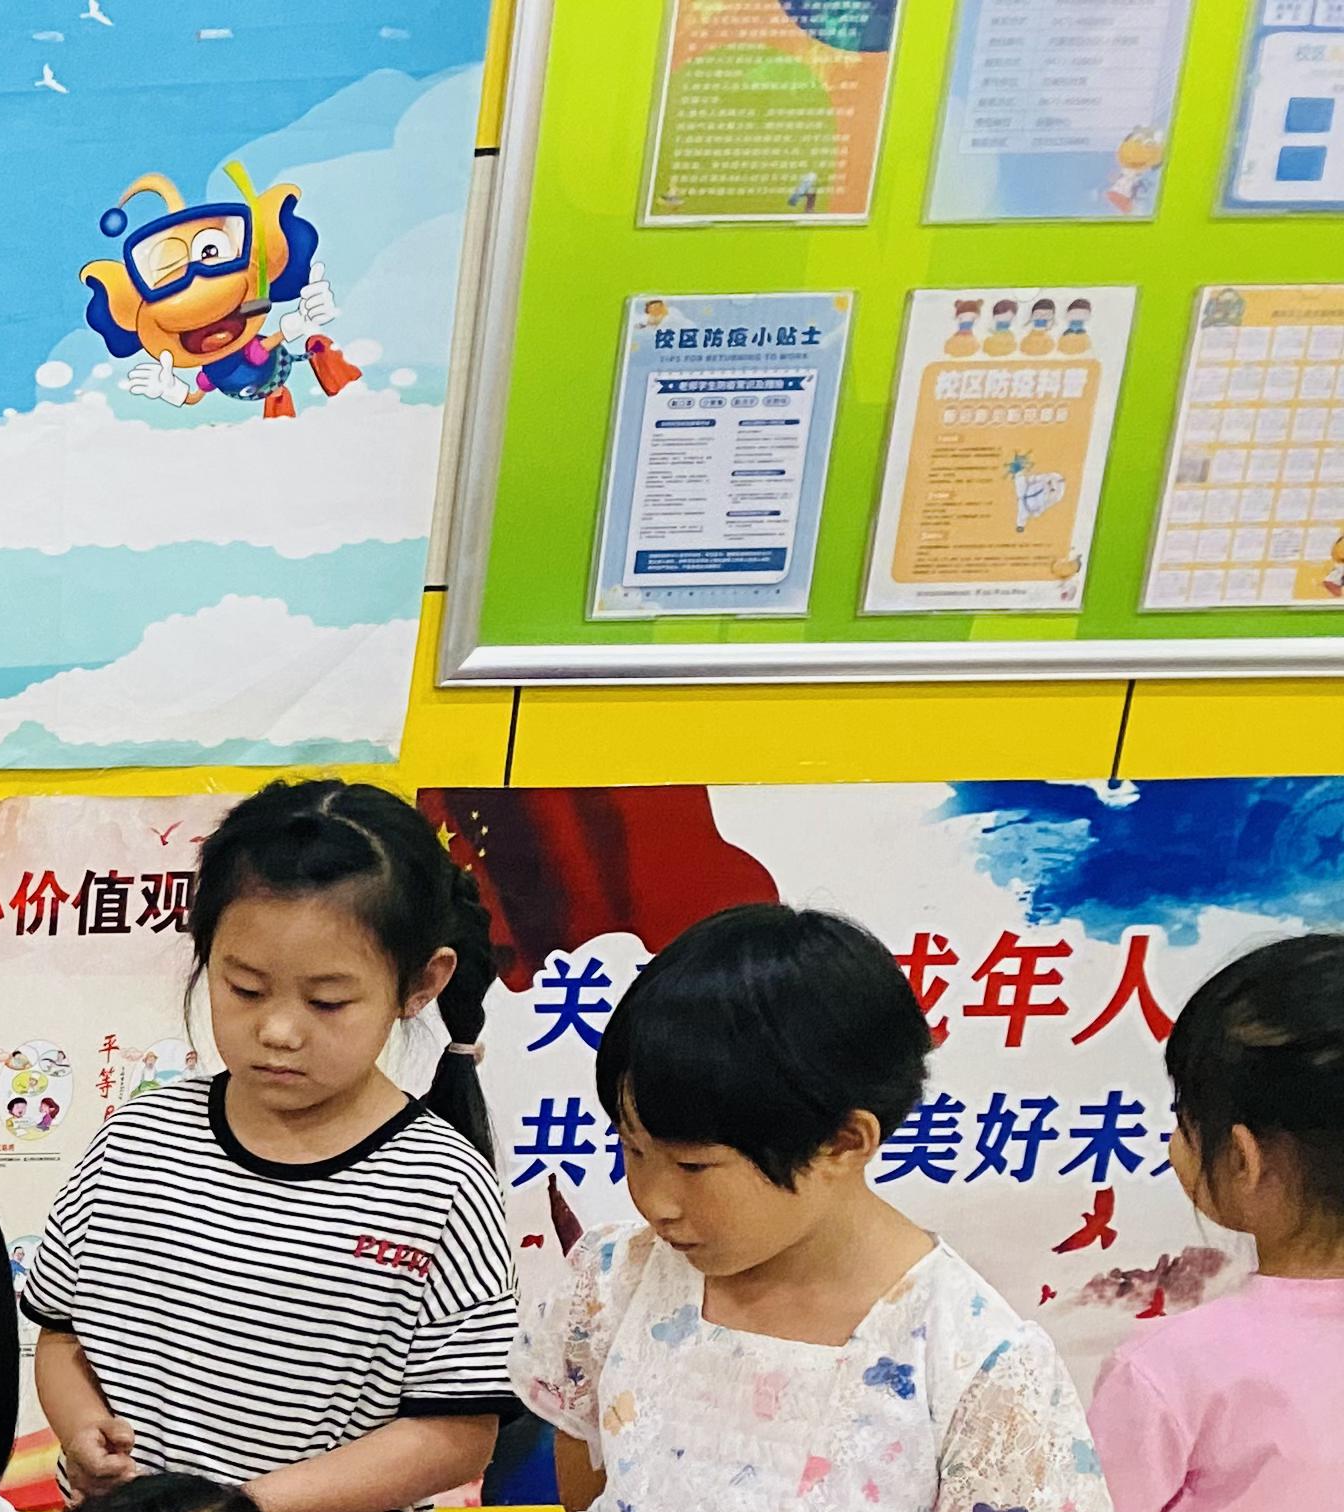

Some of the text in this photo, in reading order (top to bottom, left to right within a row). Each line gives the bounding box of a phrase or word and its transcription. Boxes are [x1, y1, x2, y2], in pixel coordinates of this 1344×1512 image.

[655, 326, 822, 350] 校区防疫小贴士
[95, 1034, 120, 1099] 平等
[874, 1090, 1176, 1185] 美好未
